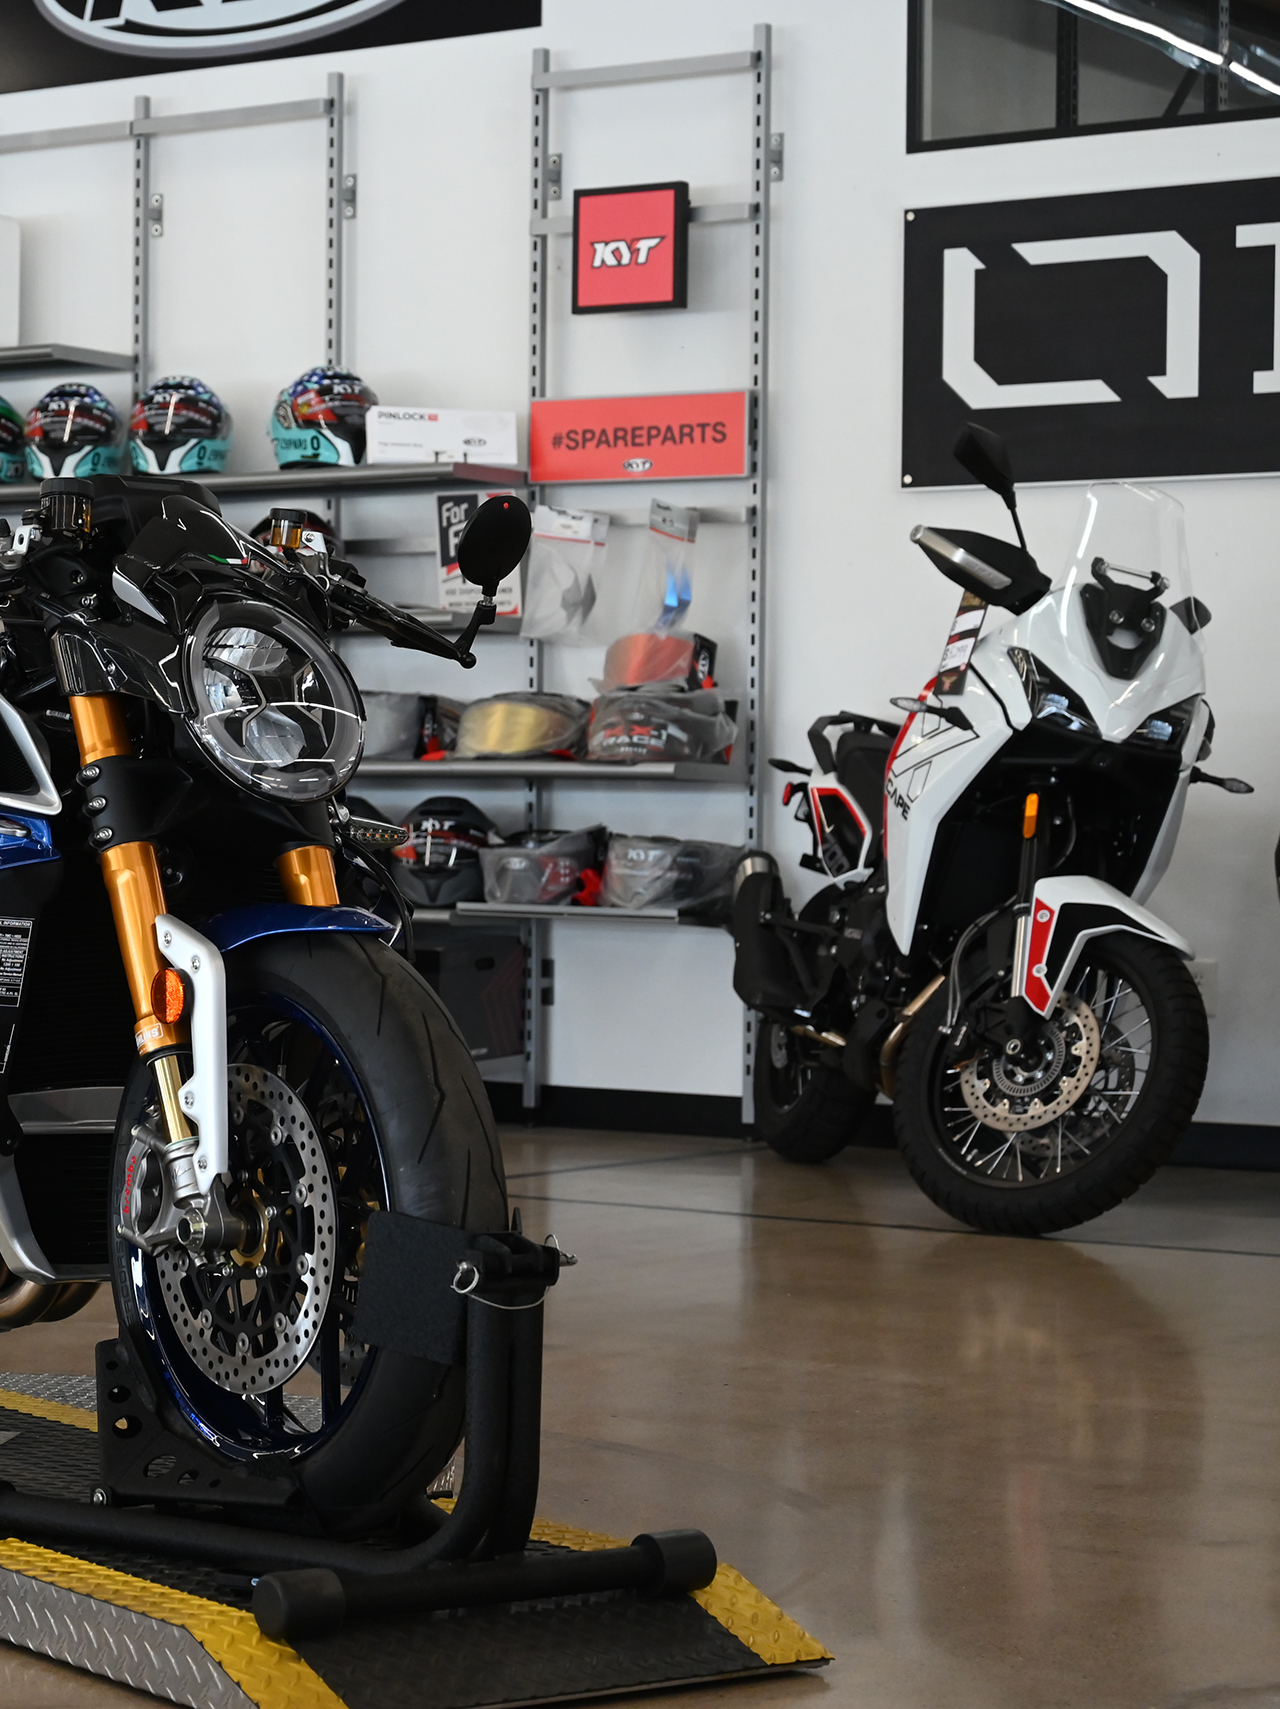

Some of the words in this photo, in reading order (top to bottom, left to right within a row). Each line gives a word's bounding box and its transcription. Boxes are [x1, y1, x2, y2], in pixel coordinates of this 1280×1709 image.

[591, 235, 666, 269] KYT
[551, 422, 728, 451] #SPAREPARTS
[441, 501, 469, 528] For
[885, 778, 911, 821] CAPE
[122, 1155, 137, 1215] brembo
